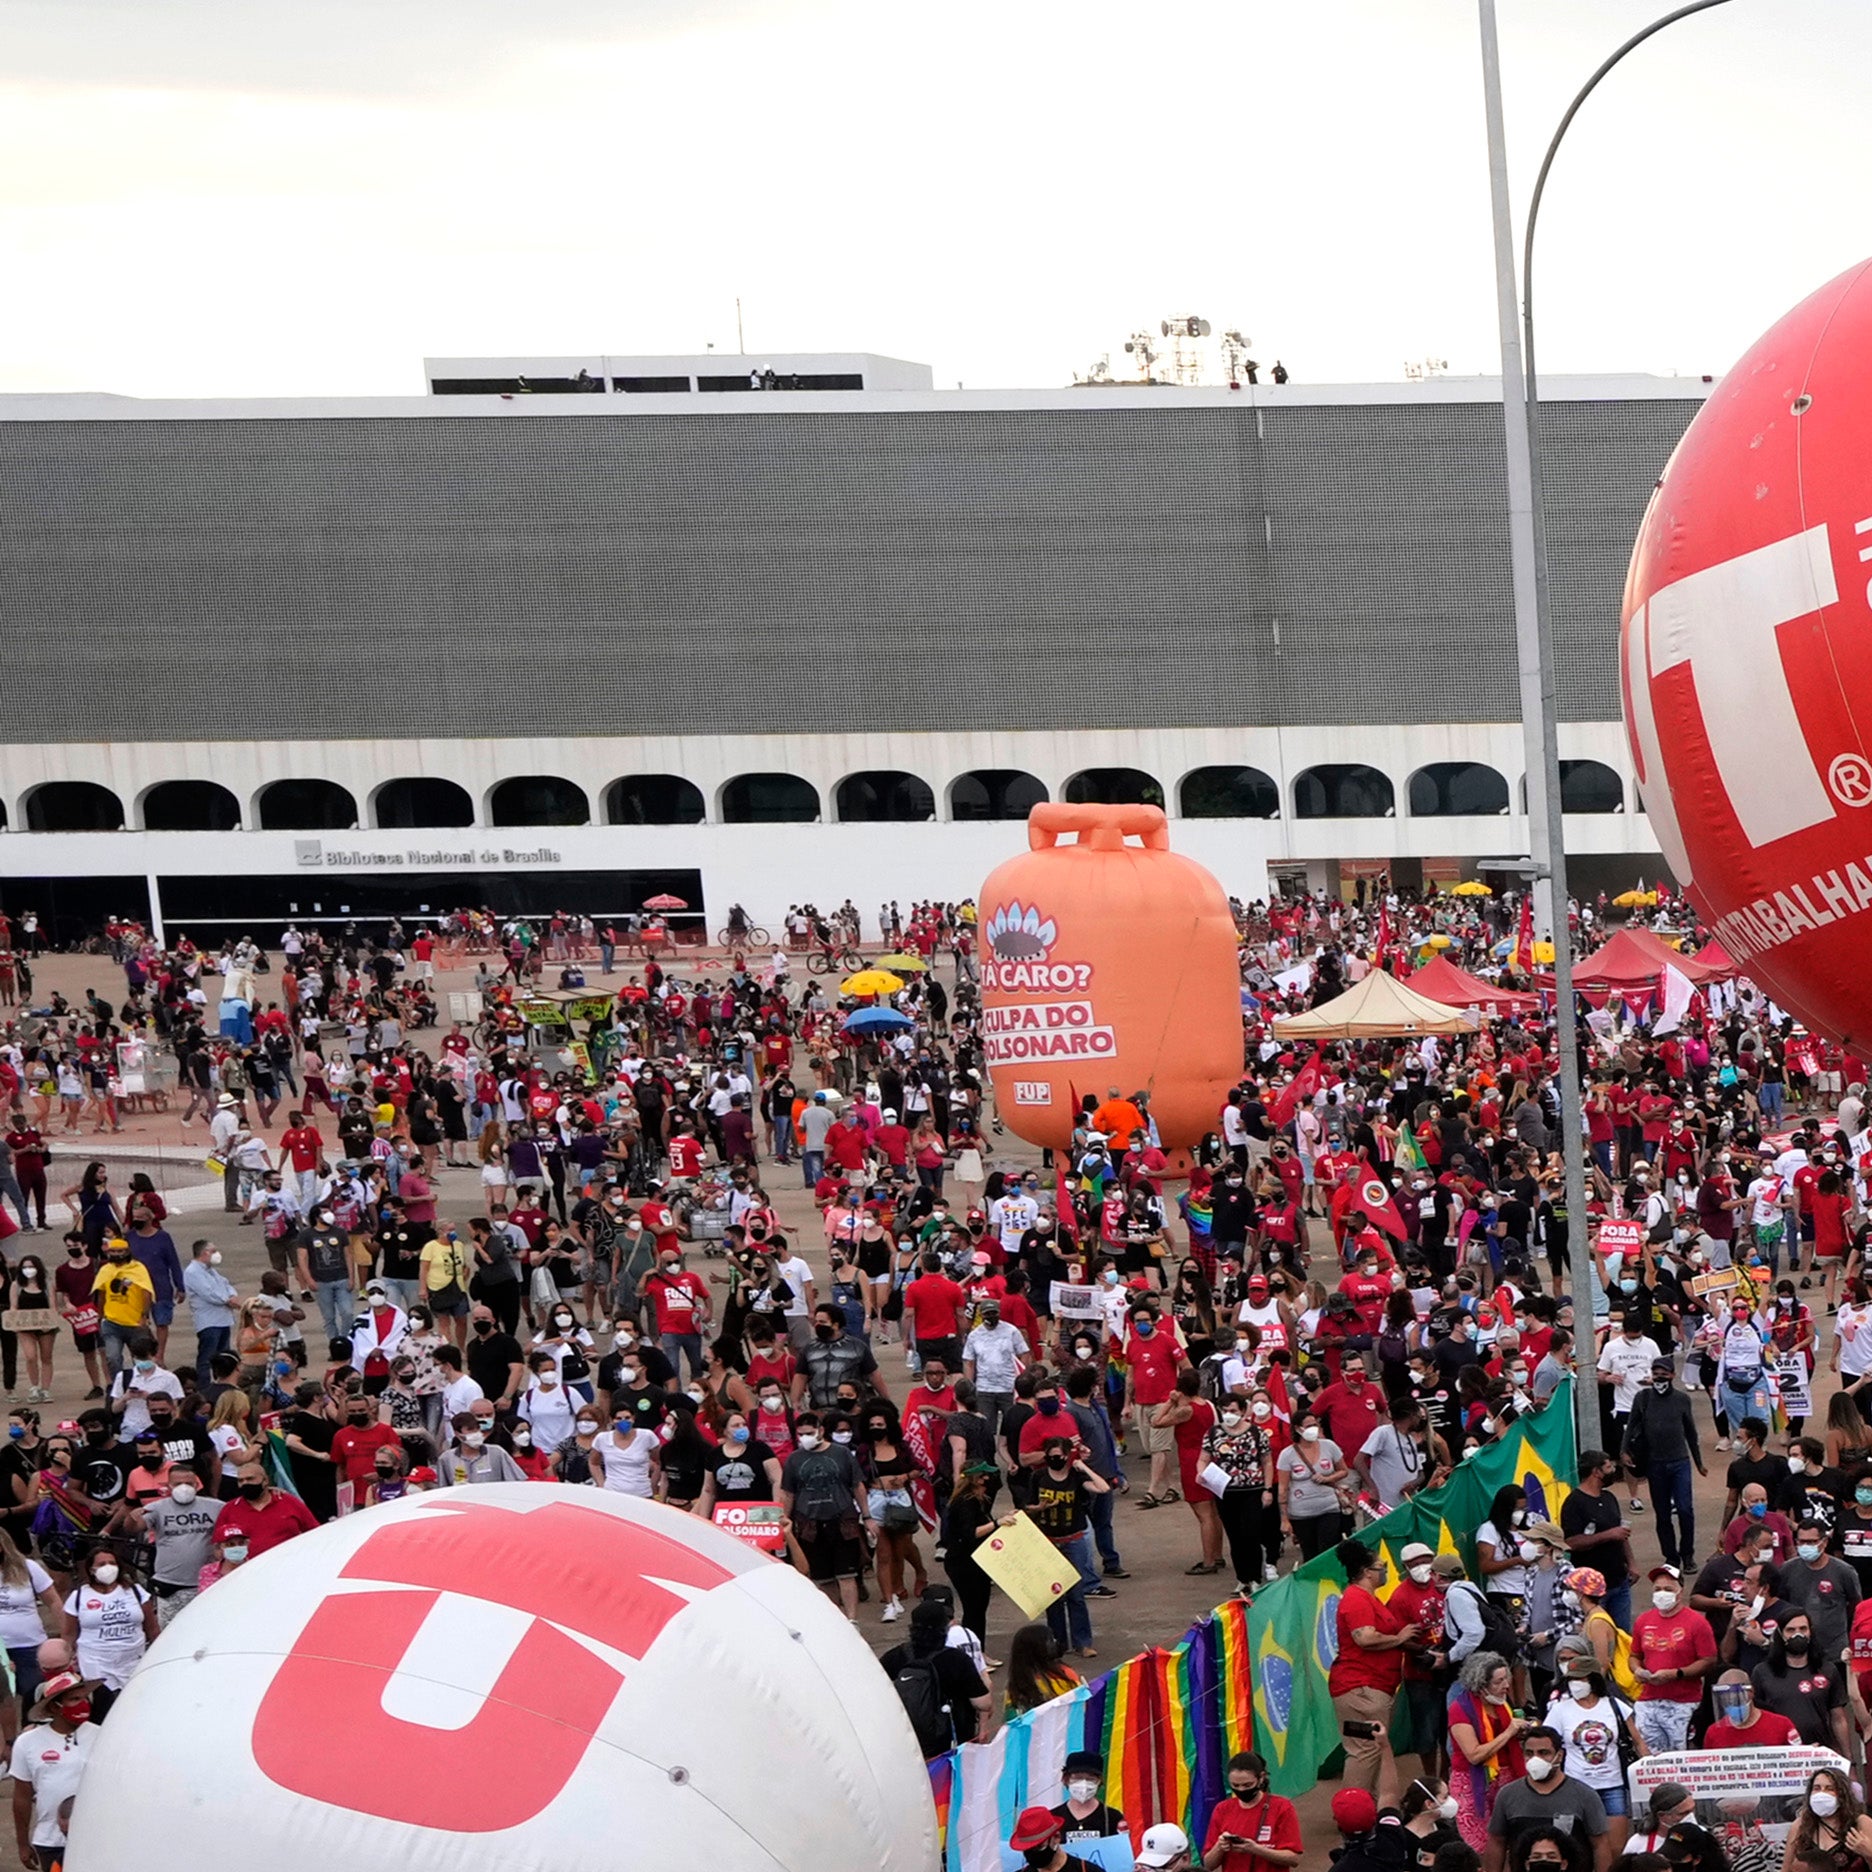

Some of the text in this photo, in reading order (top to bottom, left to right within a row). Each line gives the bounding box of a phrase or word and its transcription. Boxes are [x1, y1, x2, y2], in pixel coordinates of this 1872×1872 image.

[326, 847, 561, 866] Biblioteca Nacional de Brasília
[1001, 963, 1092, 991] CARO?
[1038, 1006, 1089, 1028] DO
[1016, 1083, 1050, 1103] FUP
[1600, 1225, 1635, 1237] FORA
[163, 1511, 214, 1529] FORA
